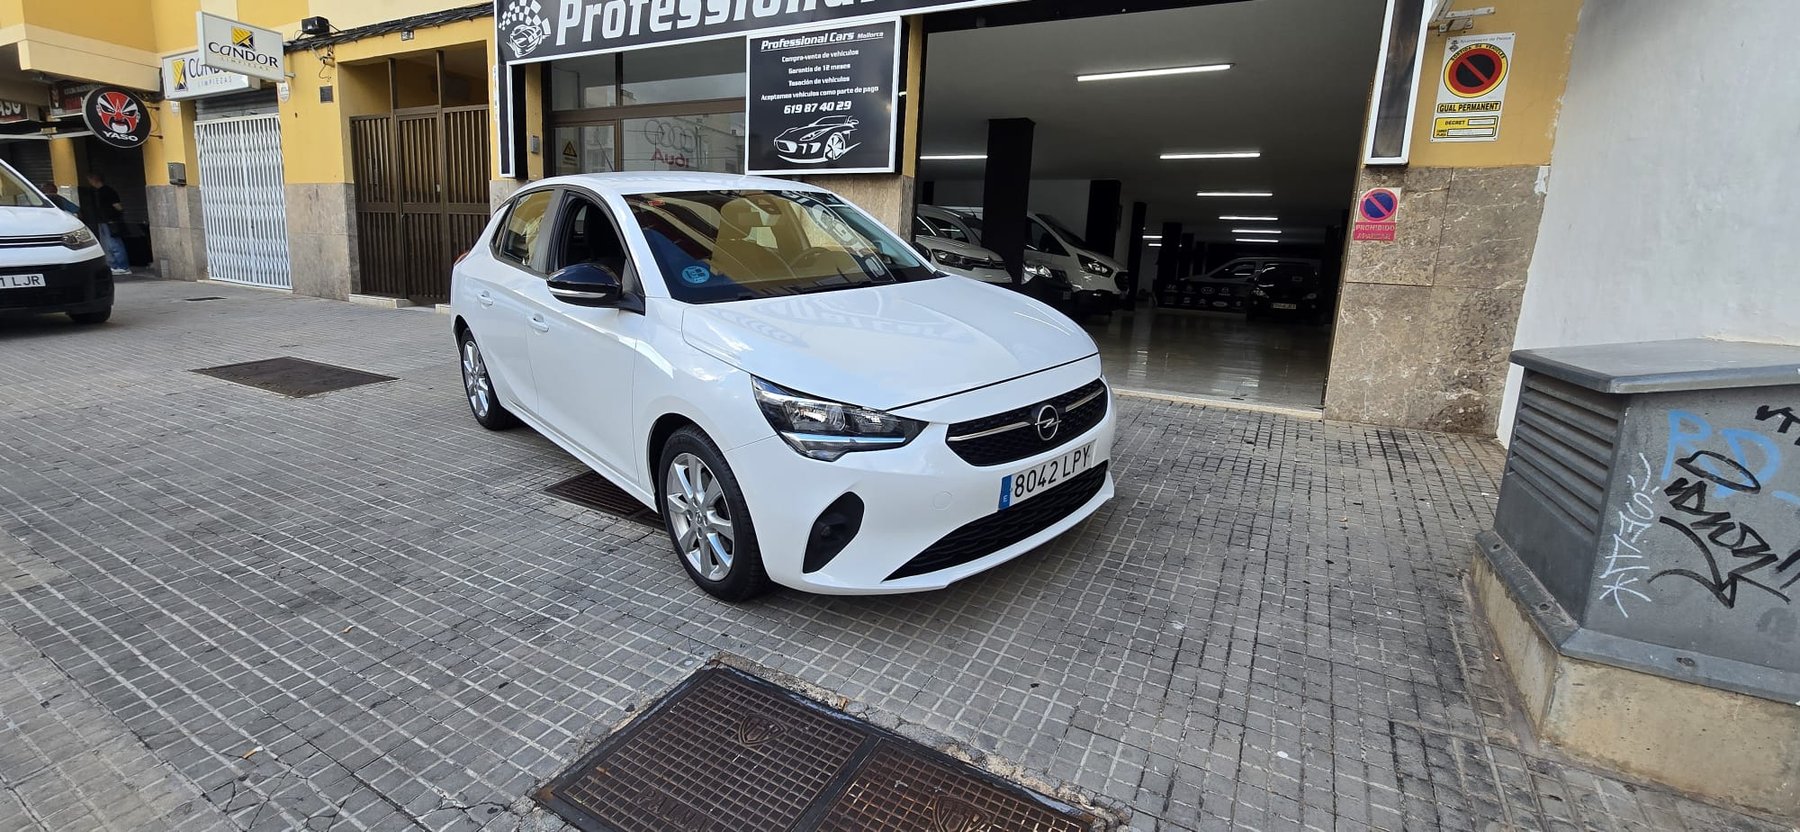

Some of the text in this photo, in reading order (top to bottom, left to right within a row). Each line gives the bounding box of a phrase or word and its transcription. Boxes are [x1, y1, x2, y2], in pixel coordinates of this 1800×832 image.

[761, 31, 884, 50] Professional Cars Mallorca
[782, 53, 821, 63] Compra-venta
[761, 93, 792, 101] Aceptamos
[837, 87, 853, 96] parte
[863, 86, 879, 94] pago
[783, 100, 852, 114] 619 87 40 29
[1440, 102, 1499, 112] GUAL PERMANENT
[102, 130, 139, 142] YASO
[651, 148, 690, 168] Audi
[12, 275, 41, 286] LJR
[1014, 445, 1091, 498] 8042 LPY
